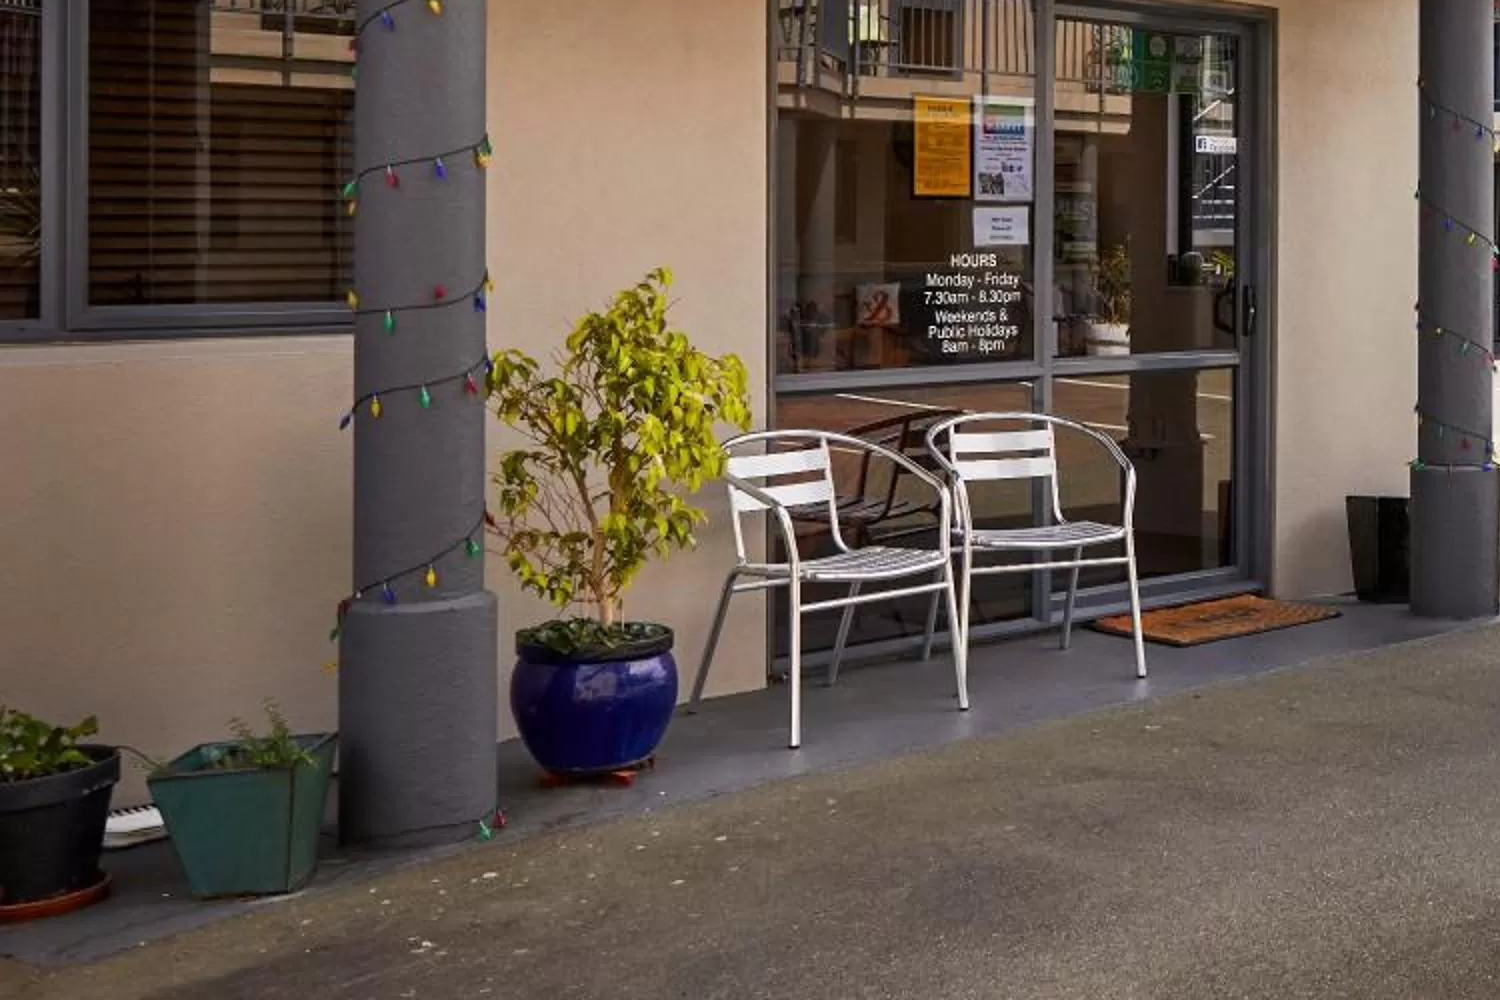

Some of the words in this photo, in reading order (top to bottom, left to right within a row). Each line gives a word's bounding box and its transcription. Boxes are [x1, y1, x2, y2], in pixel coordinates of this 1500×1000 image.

[951, 253, 997, 268] HOURS
[926, 272, 975, 289] Monday
[985, 271, 1020, 289] Friday
[924, 291, 969, 305] 7.30am
[979, 289, 1021, 306] 8.30pm
[935, 308, 997, 324] Weekends
[999, 307, 1009, 322] &
[928, 324, 967, 339] Public
[968, 323, 1019, 339] Holidays
[942, 339, 969, 353] 8am
[979, 338, 1005, 355] 8pm
